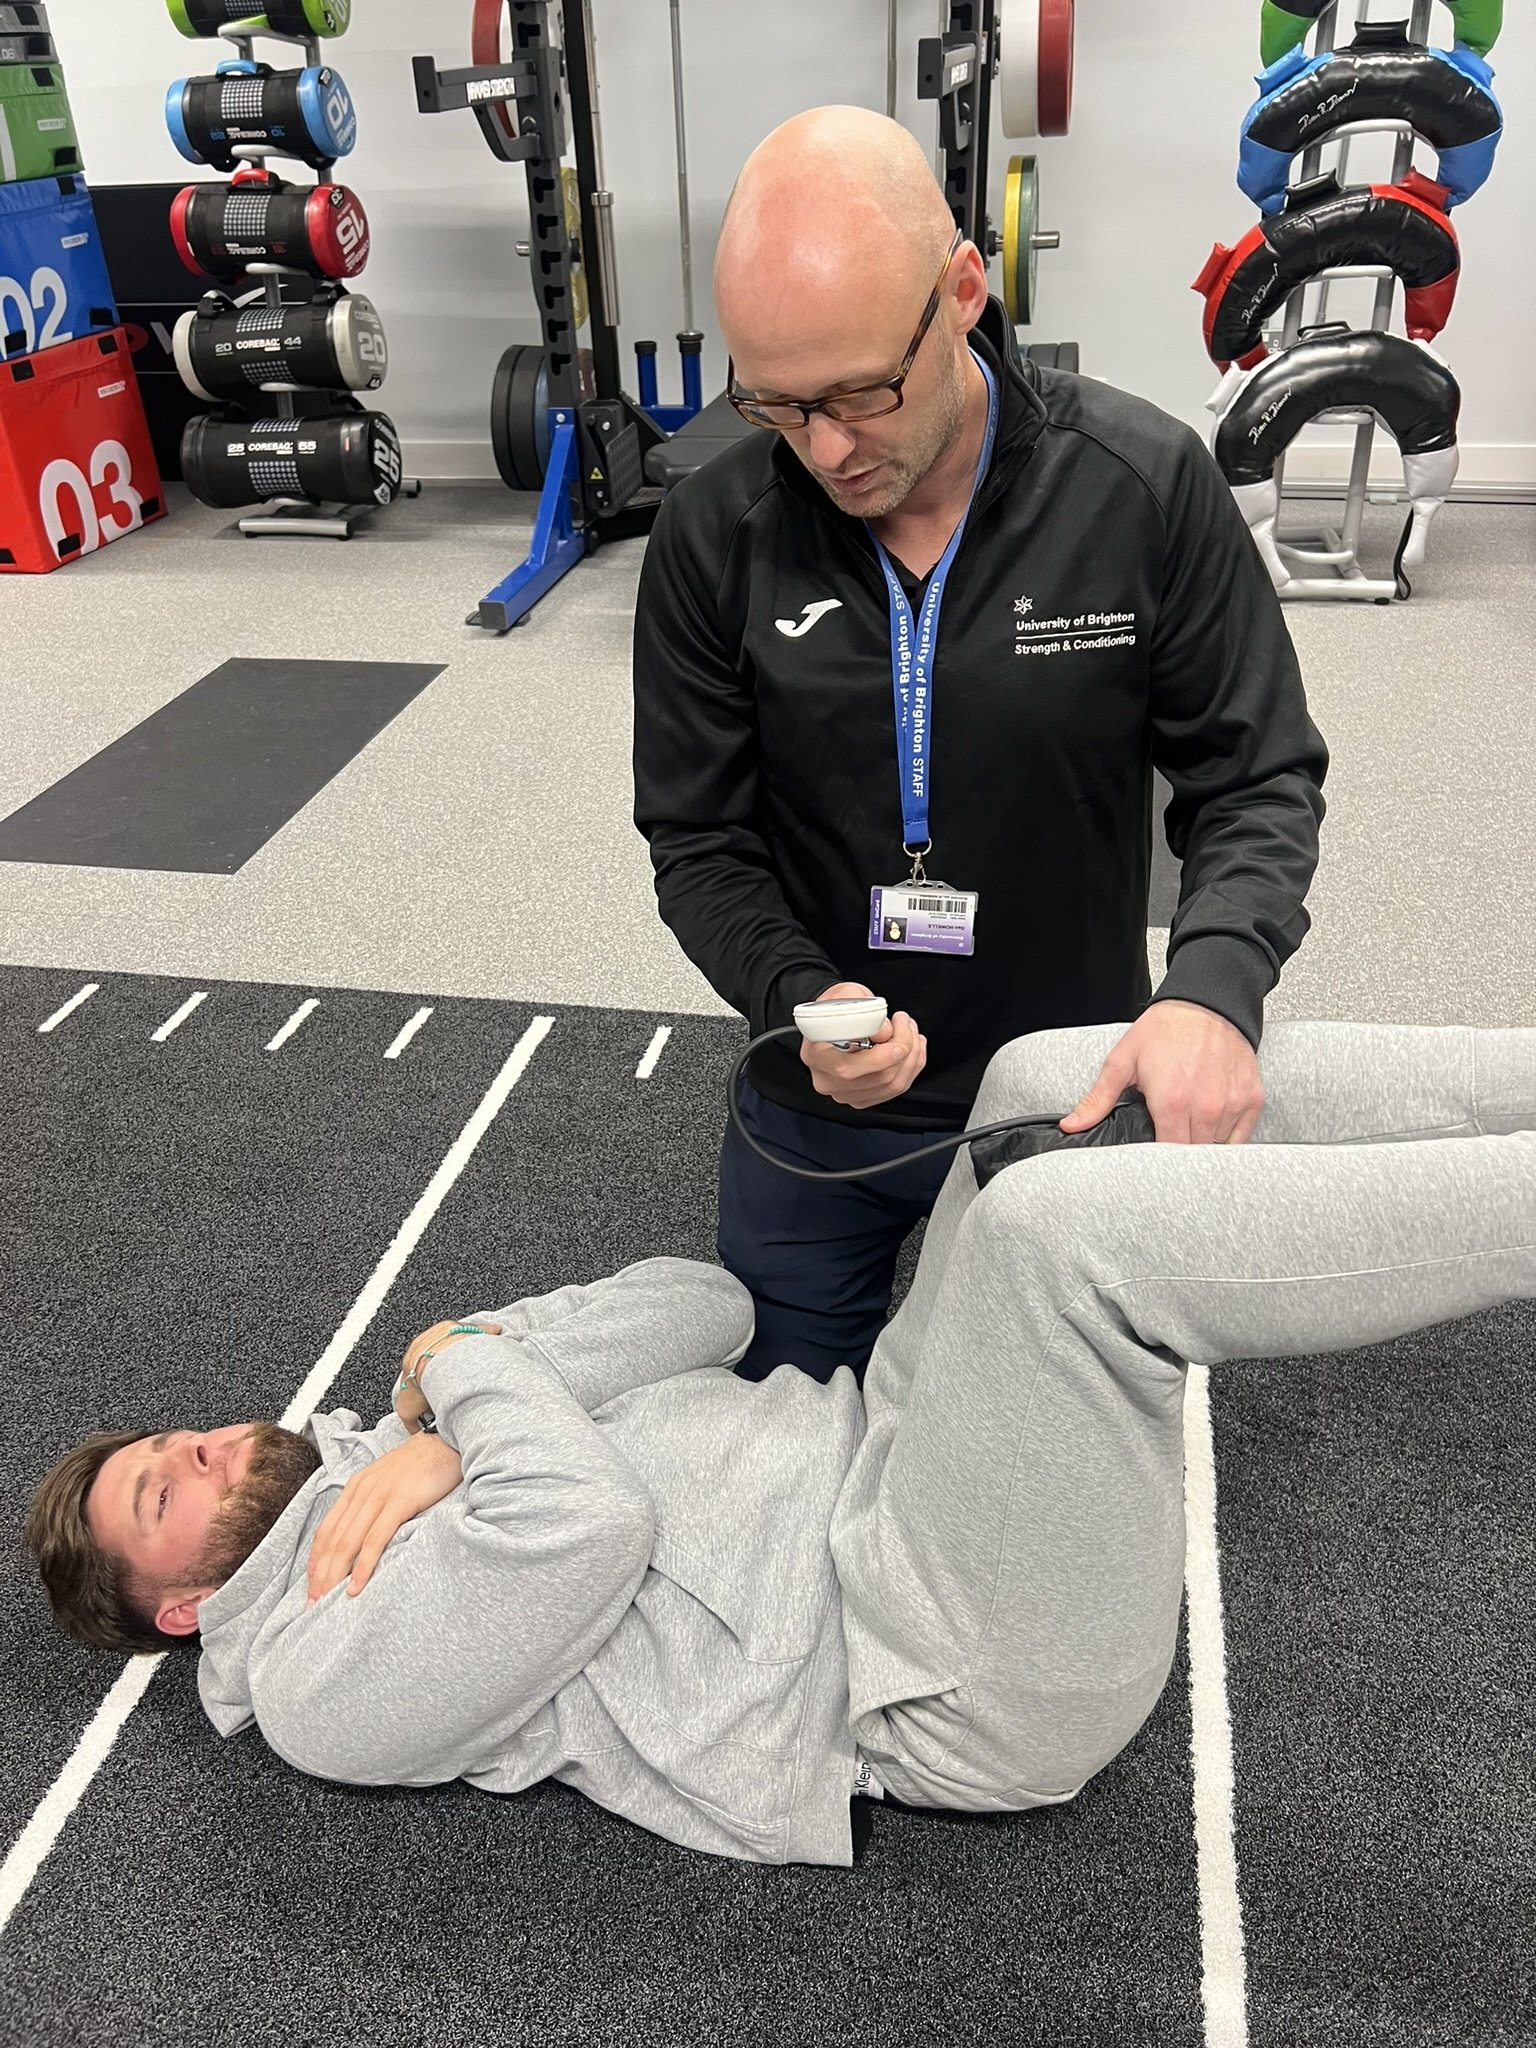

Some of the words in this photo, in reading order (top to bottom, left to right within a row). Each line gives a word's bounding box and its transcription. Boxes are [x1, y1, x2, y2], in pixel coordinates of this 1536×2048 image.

[336, 209, 365, 255] 15
[0, 266, 74, 361] 02
[358, 330, 386, 364] 20
[374, 438, 400, 484] 25
[39, 439, 144, 563] 03
[917, 581, 941, 663] University
[1016, 616, 1071, 631] University
[1073, 615, 1085, 627] of
[1088, 612, 1135, 626] Brighton
[898, 615, 912, 684] Brighton
[1015, 642, 1061, 656] Strength
[1062, 640, 1072, 651] &
[1073, 634, 1136, 650] Conditioning
[915, 667, 927, 684] of
[912, 687, 927, 753] Brighton
[912, 758, 924, 797] STAFF
[854, 1762, 872, 1789] Klein
